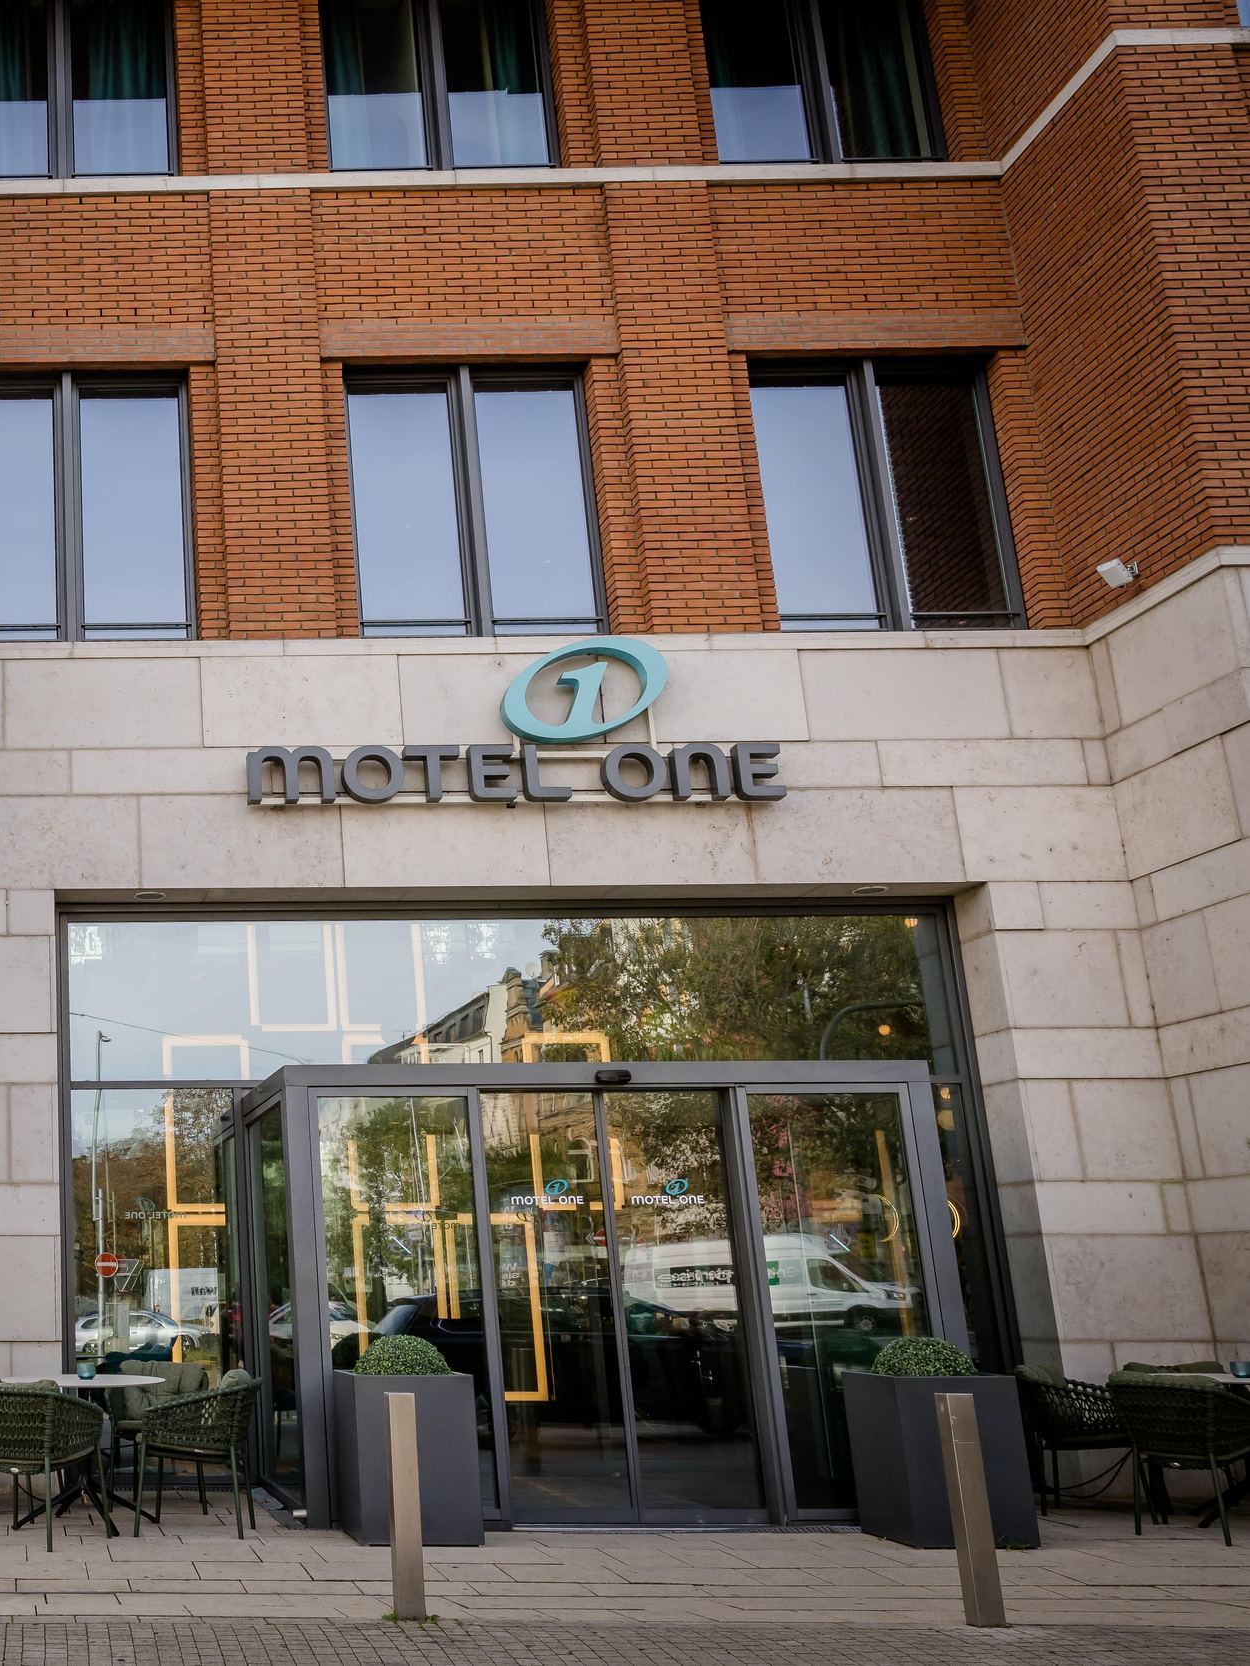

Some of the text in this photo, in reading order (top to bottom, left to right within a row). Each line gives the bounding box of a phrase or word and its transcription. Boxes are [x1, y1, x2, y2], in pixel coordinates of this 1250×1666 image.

[246, 743, 787, 804] MOTEL ONE
[511, 1195, 584, 1205] MOTEL ONE
[631, 1195, 704, 1205] MOTEL ONE
